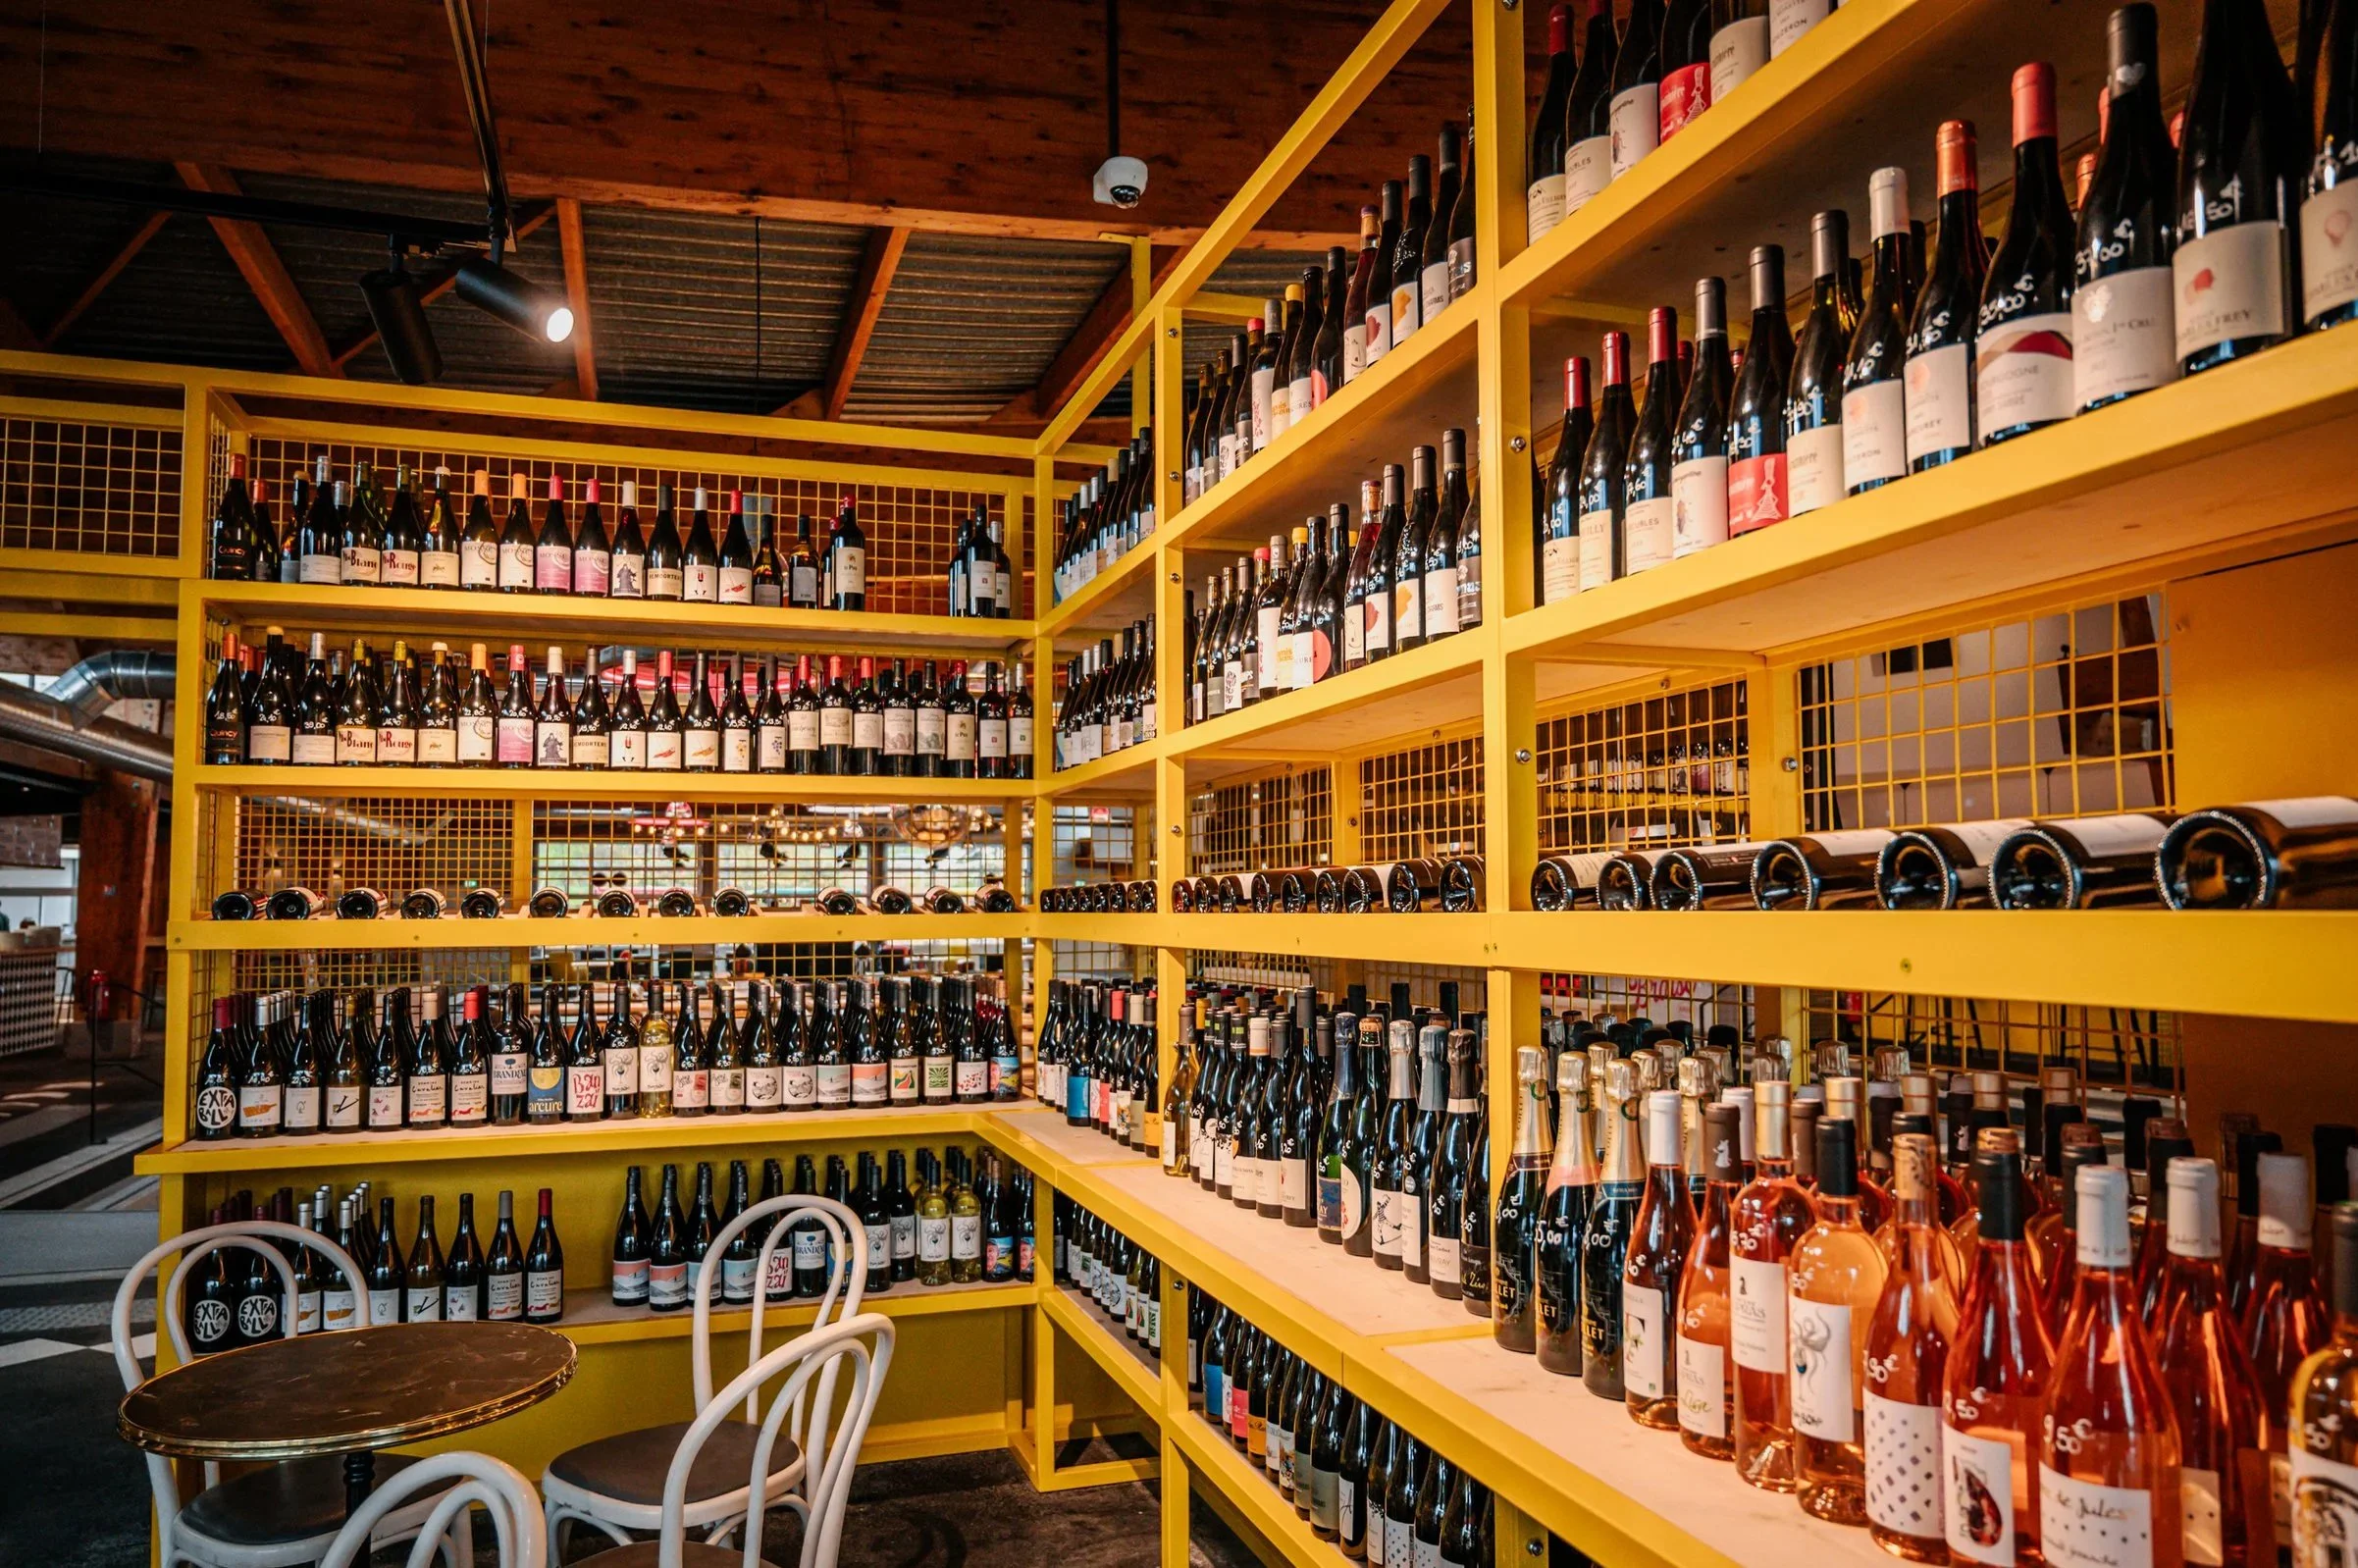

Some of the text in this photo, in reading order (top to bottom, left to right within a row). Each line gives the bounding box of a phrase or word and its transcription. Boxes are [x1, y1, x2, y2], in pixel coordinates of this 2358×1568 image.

[209, 729, 238, 738] Quincy
[199, 1089, 235, 1109] EXTRA
[528, 1100, 563, 1113] arcure
[198, 1106, 229, 1125] BALL
[239, 1297, 276, 1317] EXTRA
[239, 1315, 269, 1334] BALL
